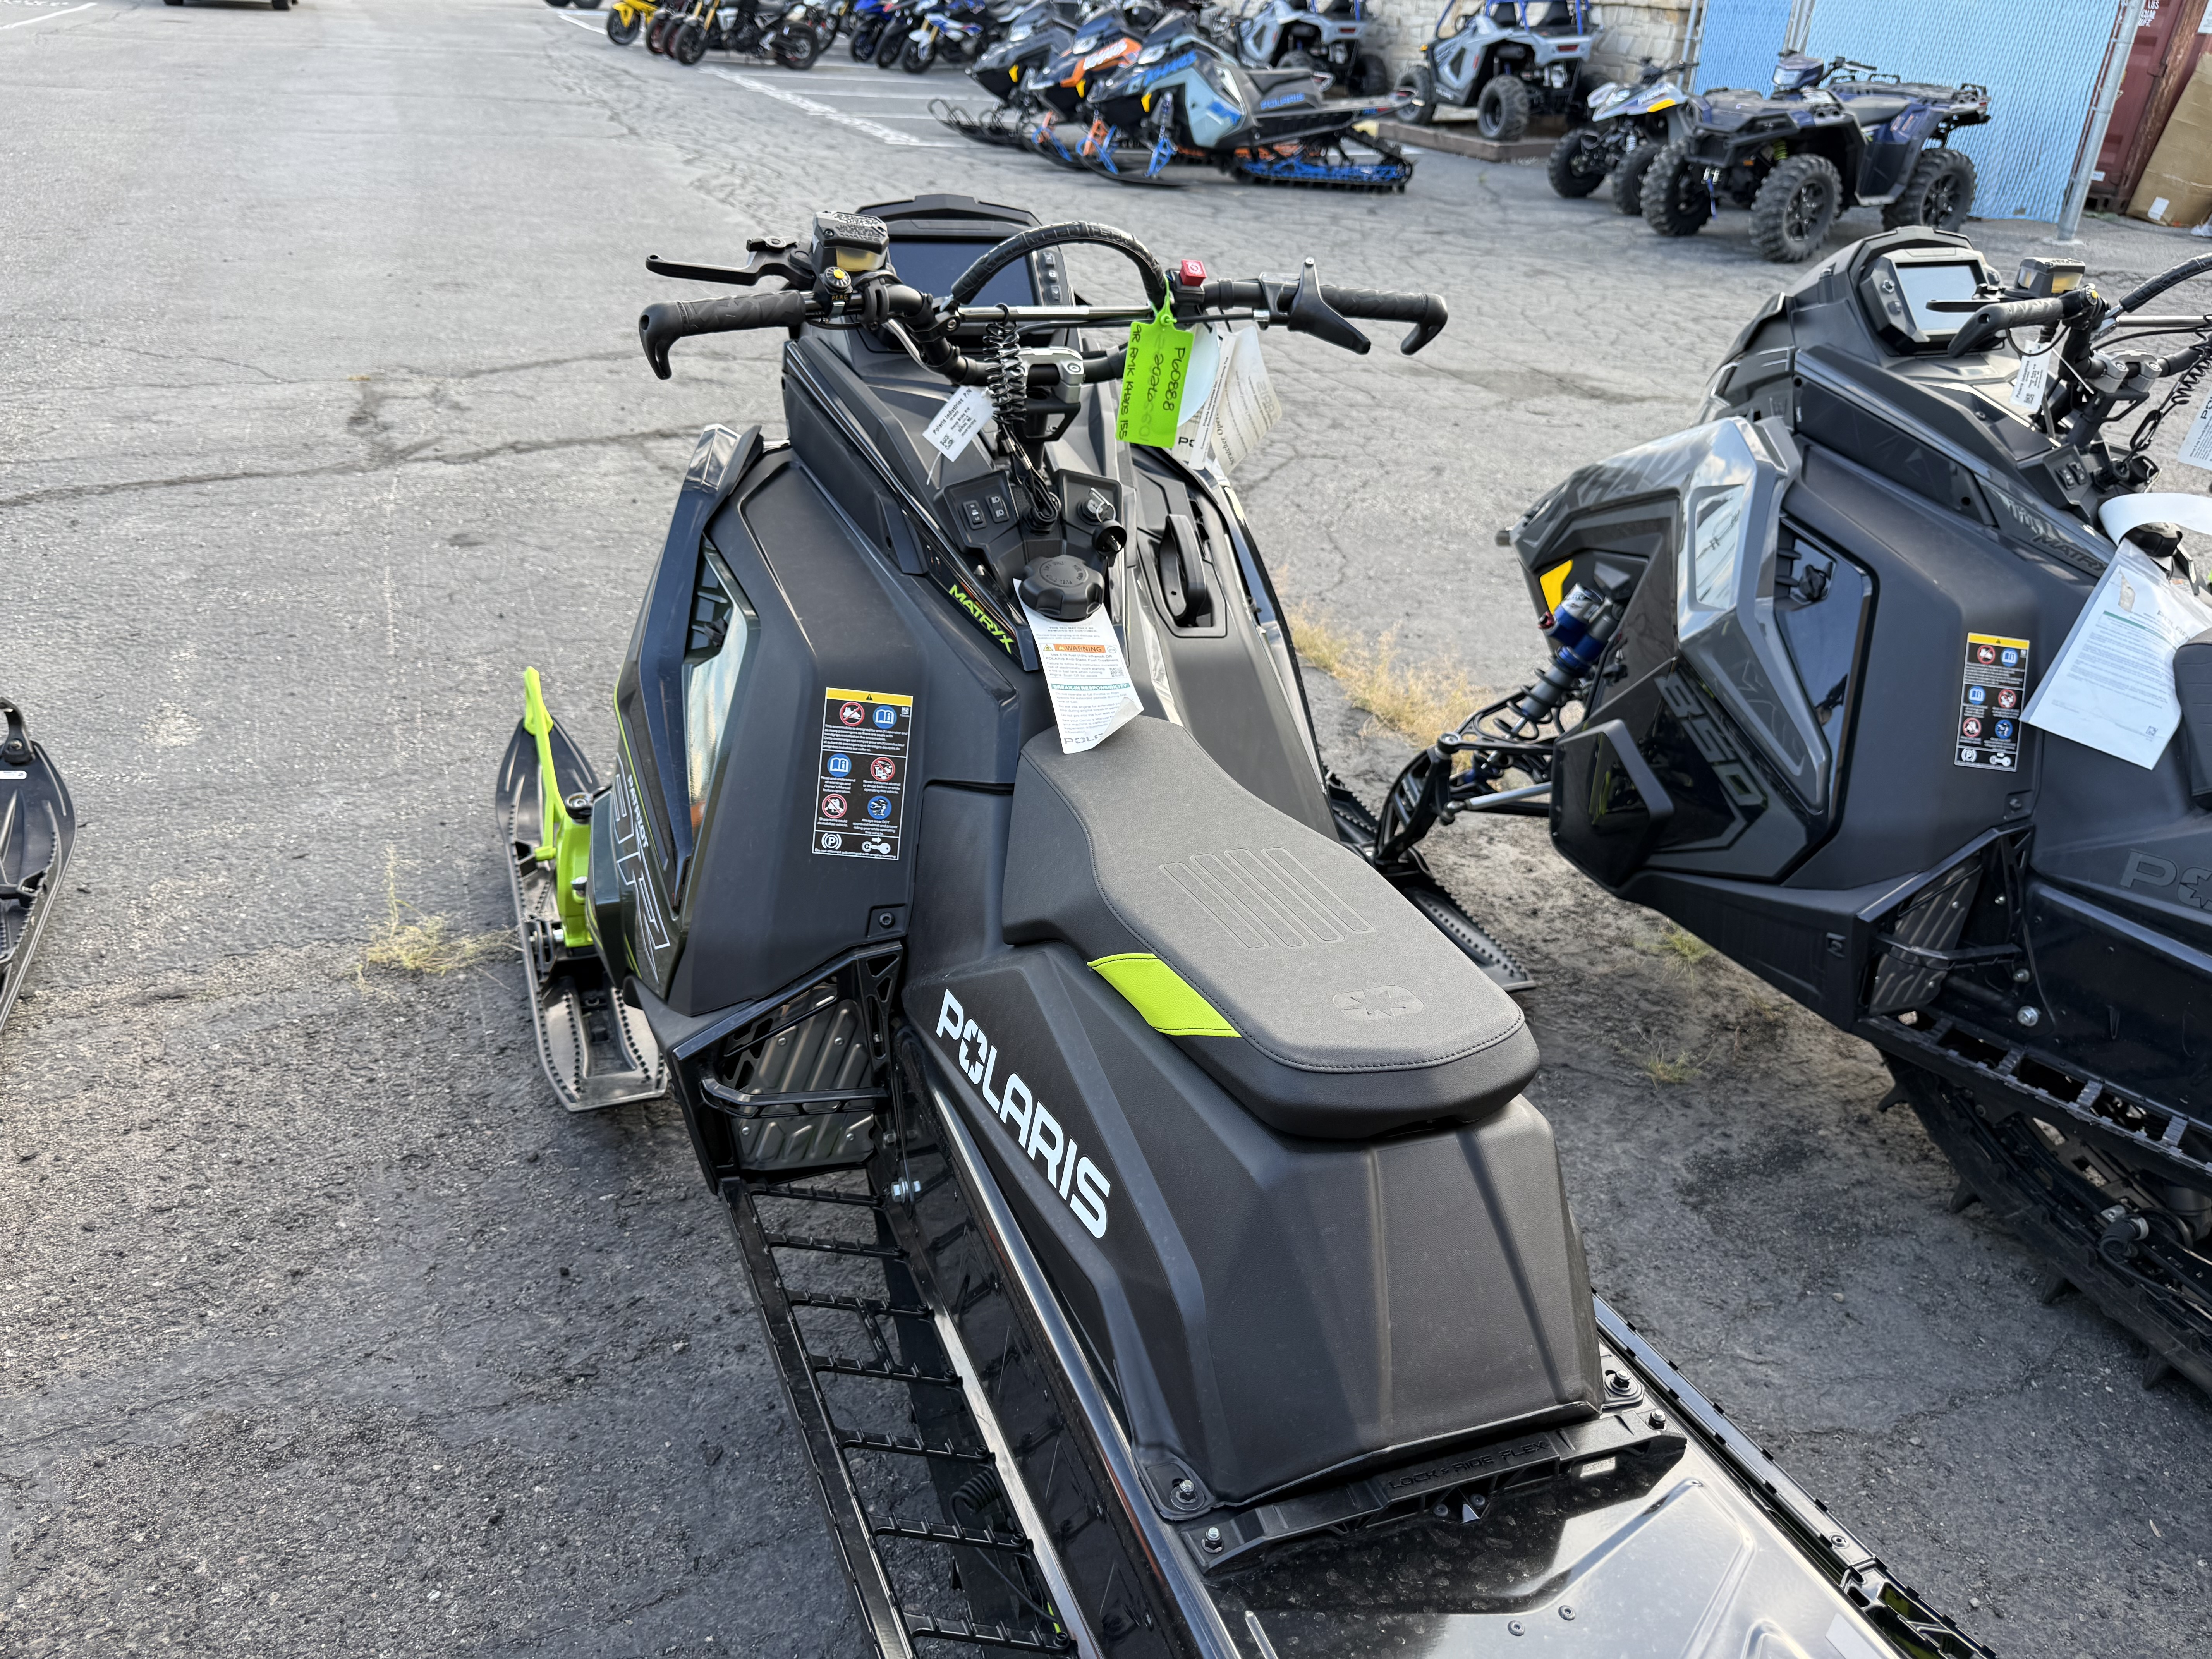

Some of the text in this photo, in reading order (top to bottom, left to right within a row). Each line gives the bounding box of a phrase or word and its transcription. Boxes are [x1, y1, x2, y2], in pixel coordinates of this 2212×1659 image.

[1127, 348, 1138, 376] RMK
[1132, 325, 1142, 342] 9R
[1163, 347, 1185, 411] P60888
[1119, 420, 1128, 440] 155
[948, 584, 1016, 654] MATRYX
[1654, 673, 1765, 806] 850
[628, 775, 648, 848] PATRIOT
[936, 989, 1111, 1238] POLARIS
[1388, 1470, 1438, 1489] LOCK
[1451, 1455, 1495, 1472] RIDE
[1499, 1441, 1547, 1460] FLEX
